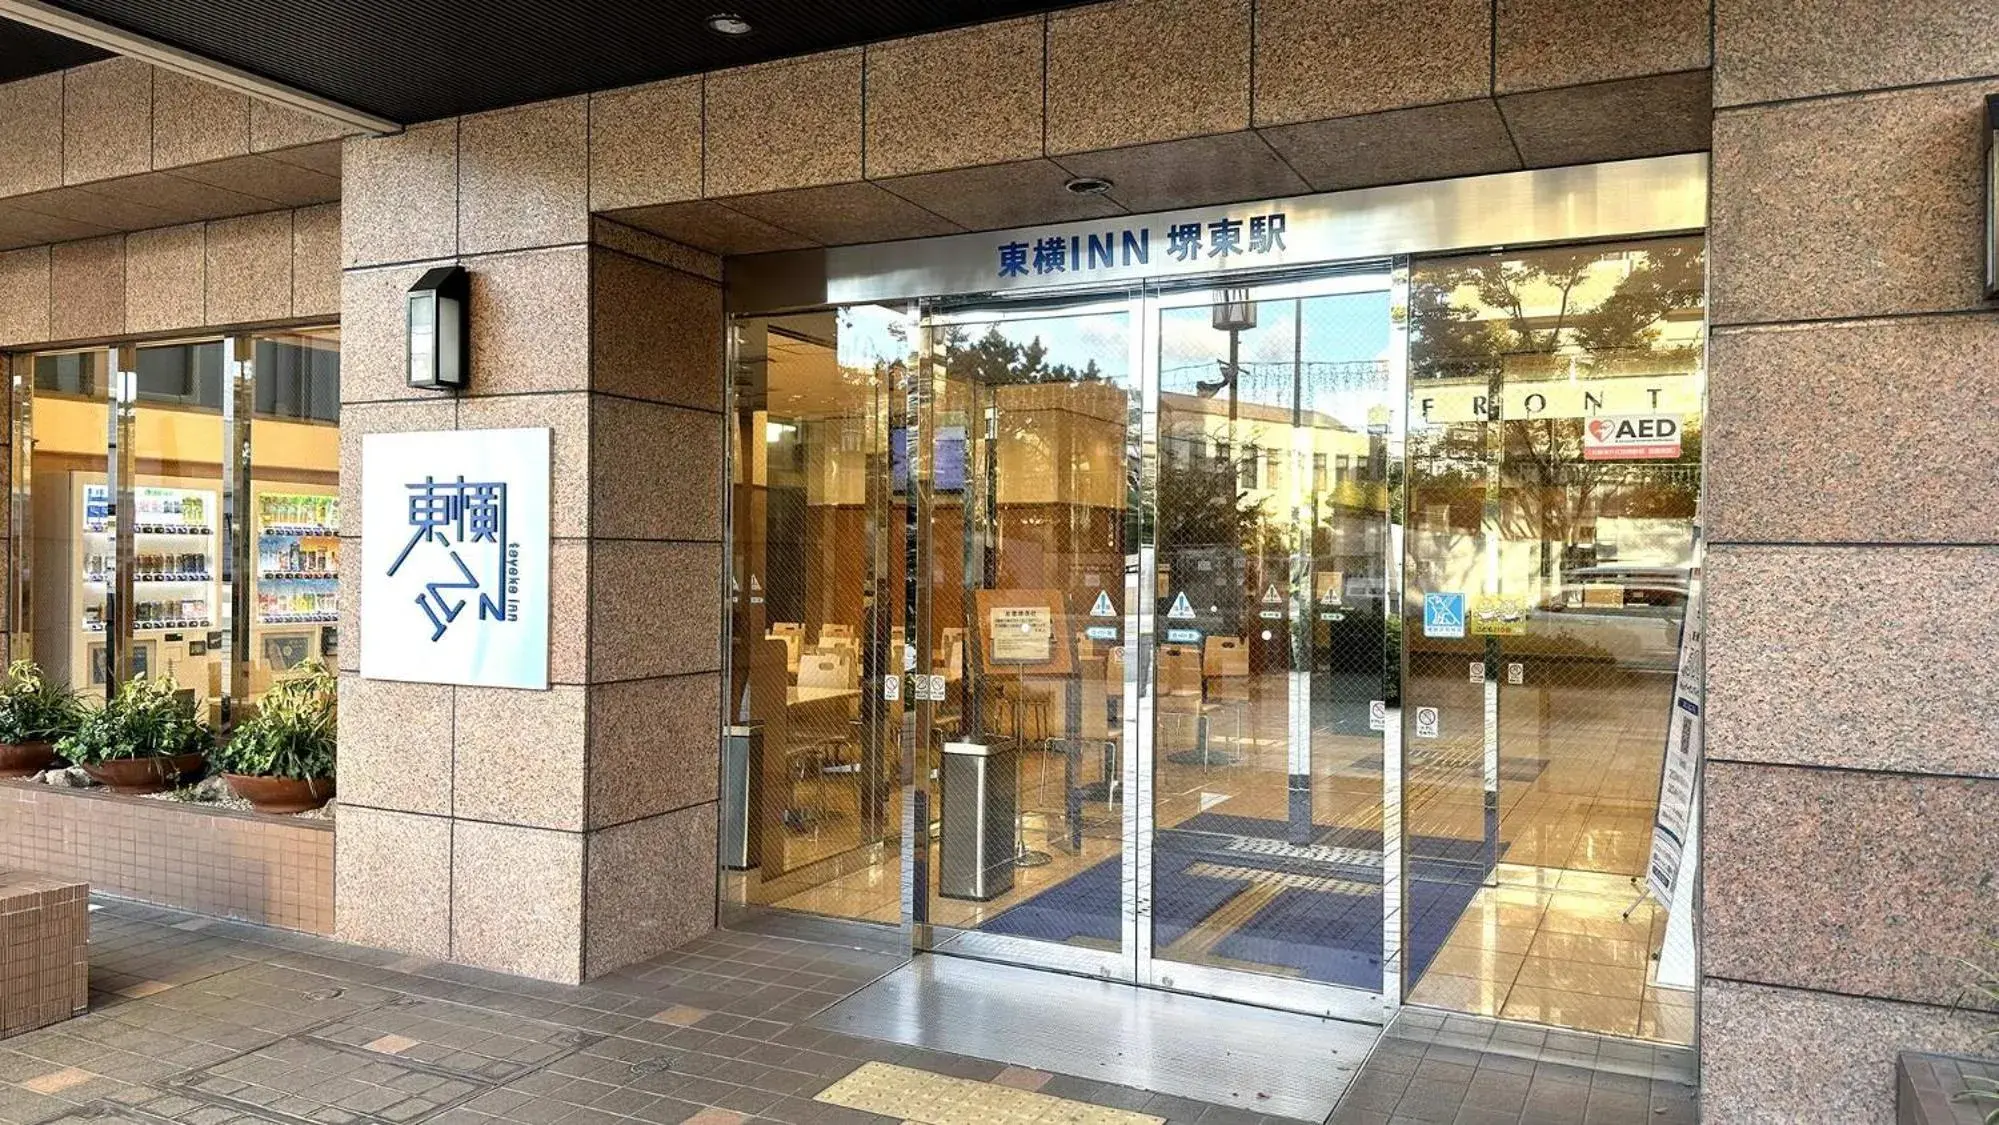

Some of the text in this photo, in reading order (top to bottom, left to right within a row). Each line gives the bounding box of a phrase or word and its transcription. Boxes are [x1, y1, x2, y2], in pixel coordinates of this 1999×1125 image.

[998, 213, 1287, 277] 東横INN 堺東駅
[1422, 388, 1662, 417] FRONT
[1615, 419, 1677, 438] AED
[507, 543, 520, 594] toyoko
